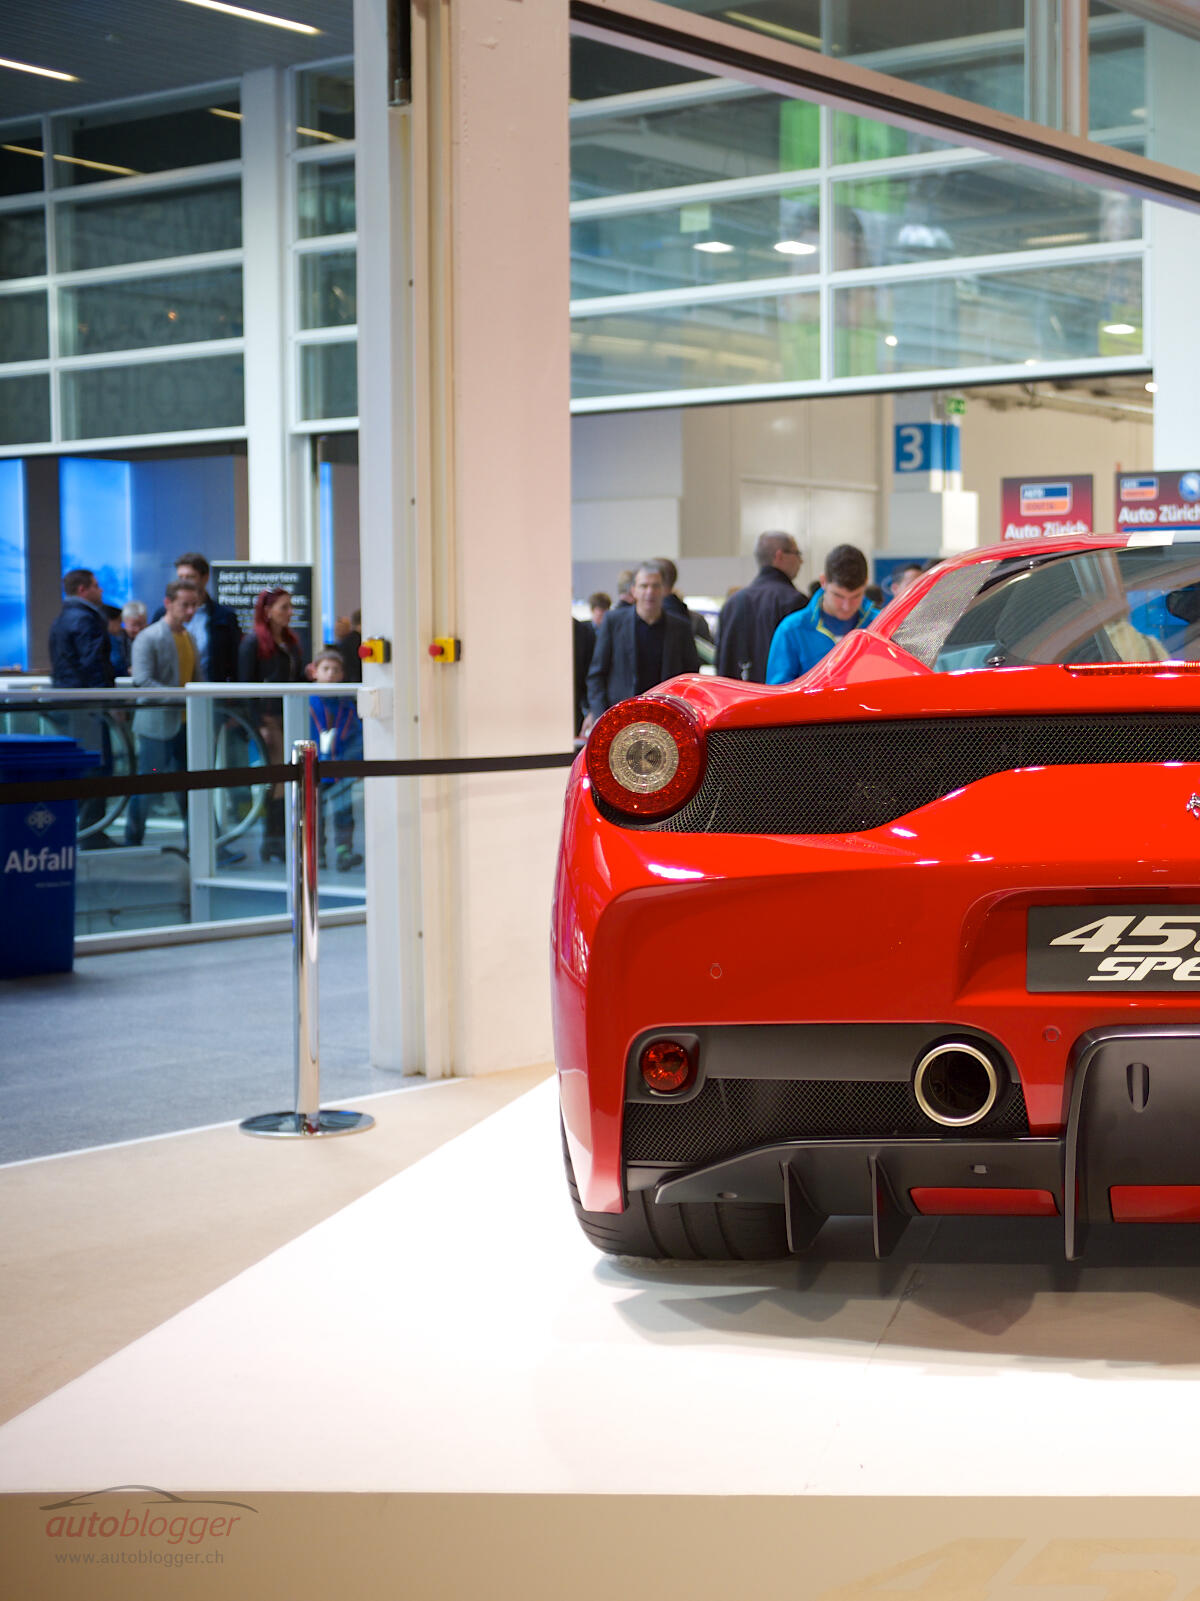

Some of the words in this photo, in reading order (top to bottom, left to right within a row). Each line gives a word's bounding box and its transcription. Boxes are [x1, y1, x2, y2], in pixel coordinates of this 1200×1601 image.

[899, 426, 924, 470] 3
[1118, 505, 1157, 524] Auto
[1004, 522, 1042, 539] Auto
[218, 571, 245, 583] Jetzt
[246, 571, 298, 583] bewerten
[218, 583, 241, 594] und
[4, 846, 74, 874] Abfall
